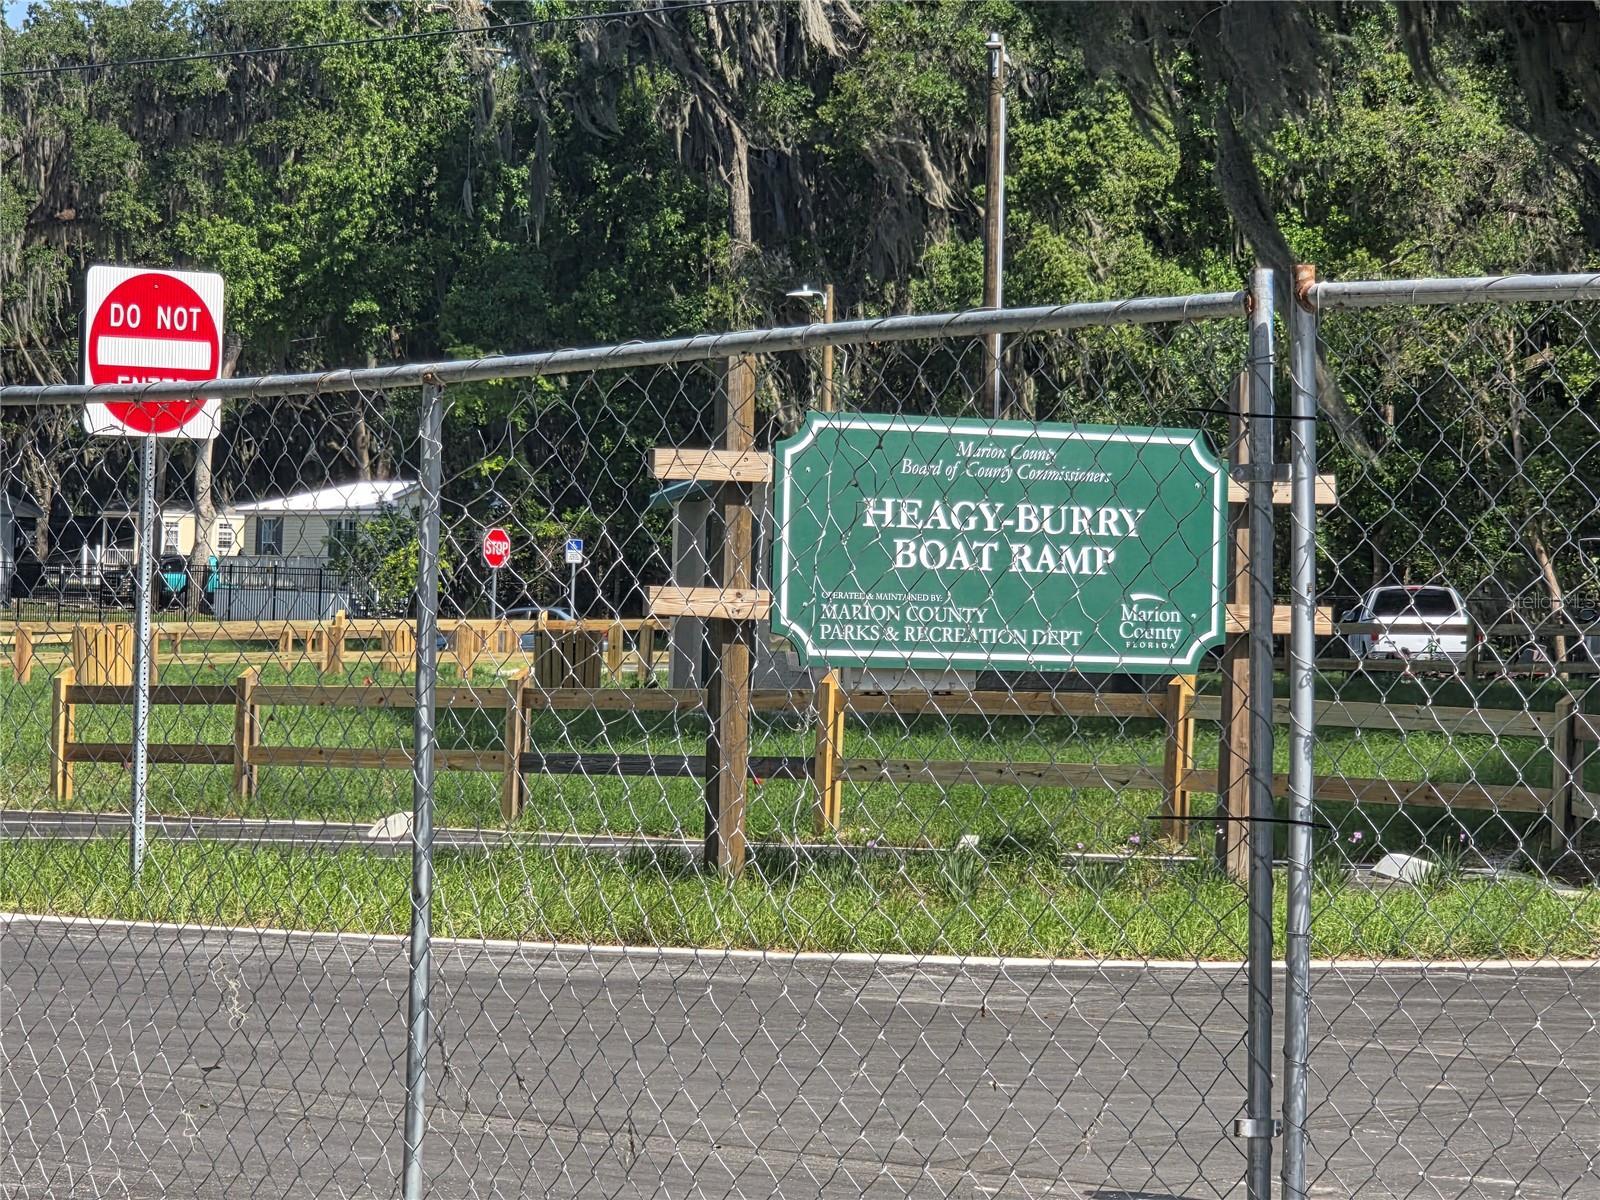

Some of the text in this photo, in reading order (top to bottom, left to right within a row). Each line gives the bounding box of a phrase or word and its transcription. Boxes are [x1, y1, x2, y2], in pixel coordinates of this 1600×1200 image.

[110, 302, 202, 332] DO NOT
[956, 441, 1057, 465] Marion County
[901, 458, 1113, 483] Board of County Commissioners
[862, 498, 1147, 538] HEAGY-BURRY
[486, 541, 508, 555] STOP
[893, 539, 1117, 575] BOAT RAMP
[821, 591, 866, 600] OPERATED
[875, 592, 929, 602] MAINTAINED
[820, 603, 989, 624] MARION COUNTY
[1120, 604, 1181, 622] Marion
[819, 624, 1083, 646] PARKS & RECREATION DEPT
[1119, 621, 1182, 644] County
[1126, 641, 1175, 649] FLORIDA
